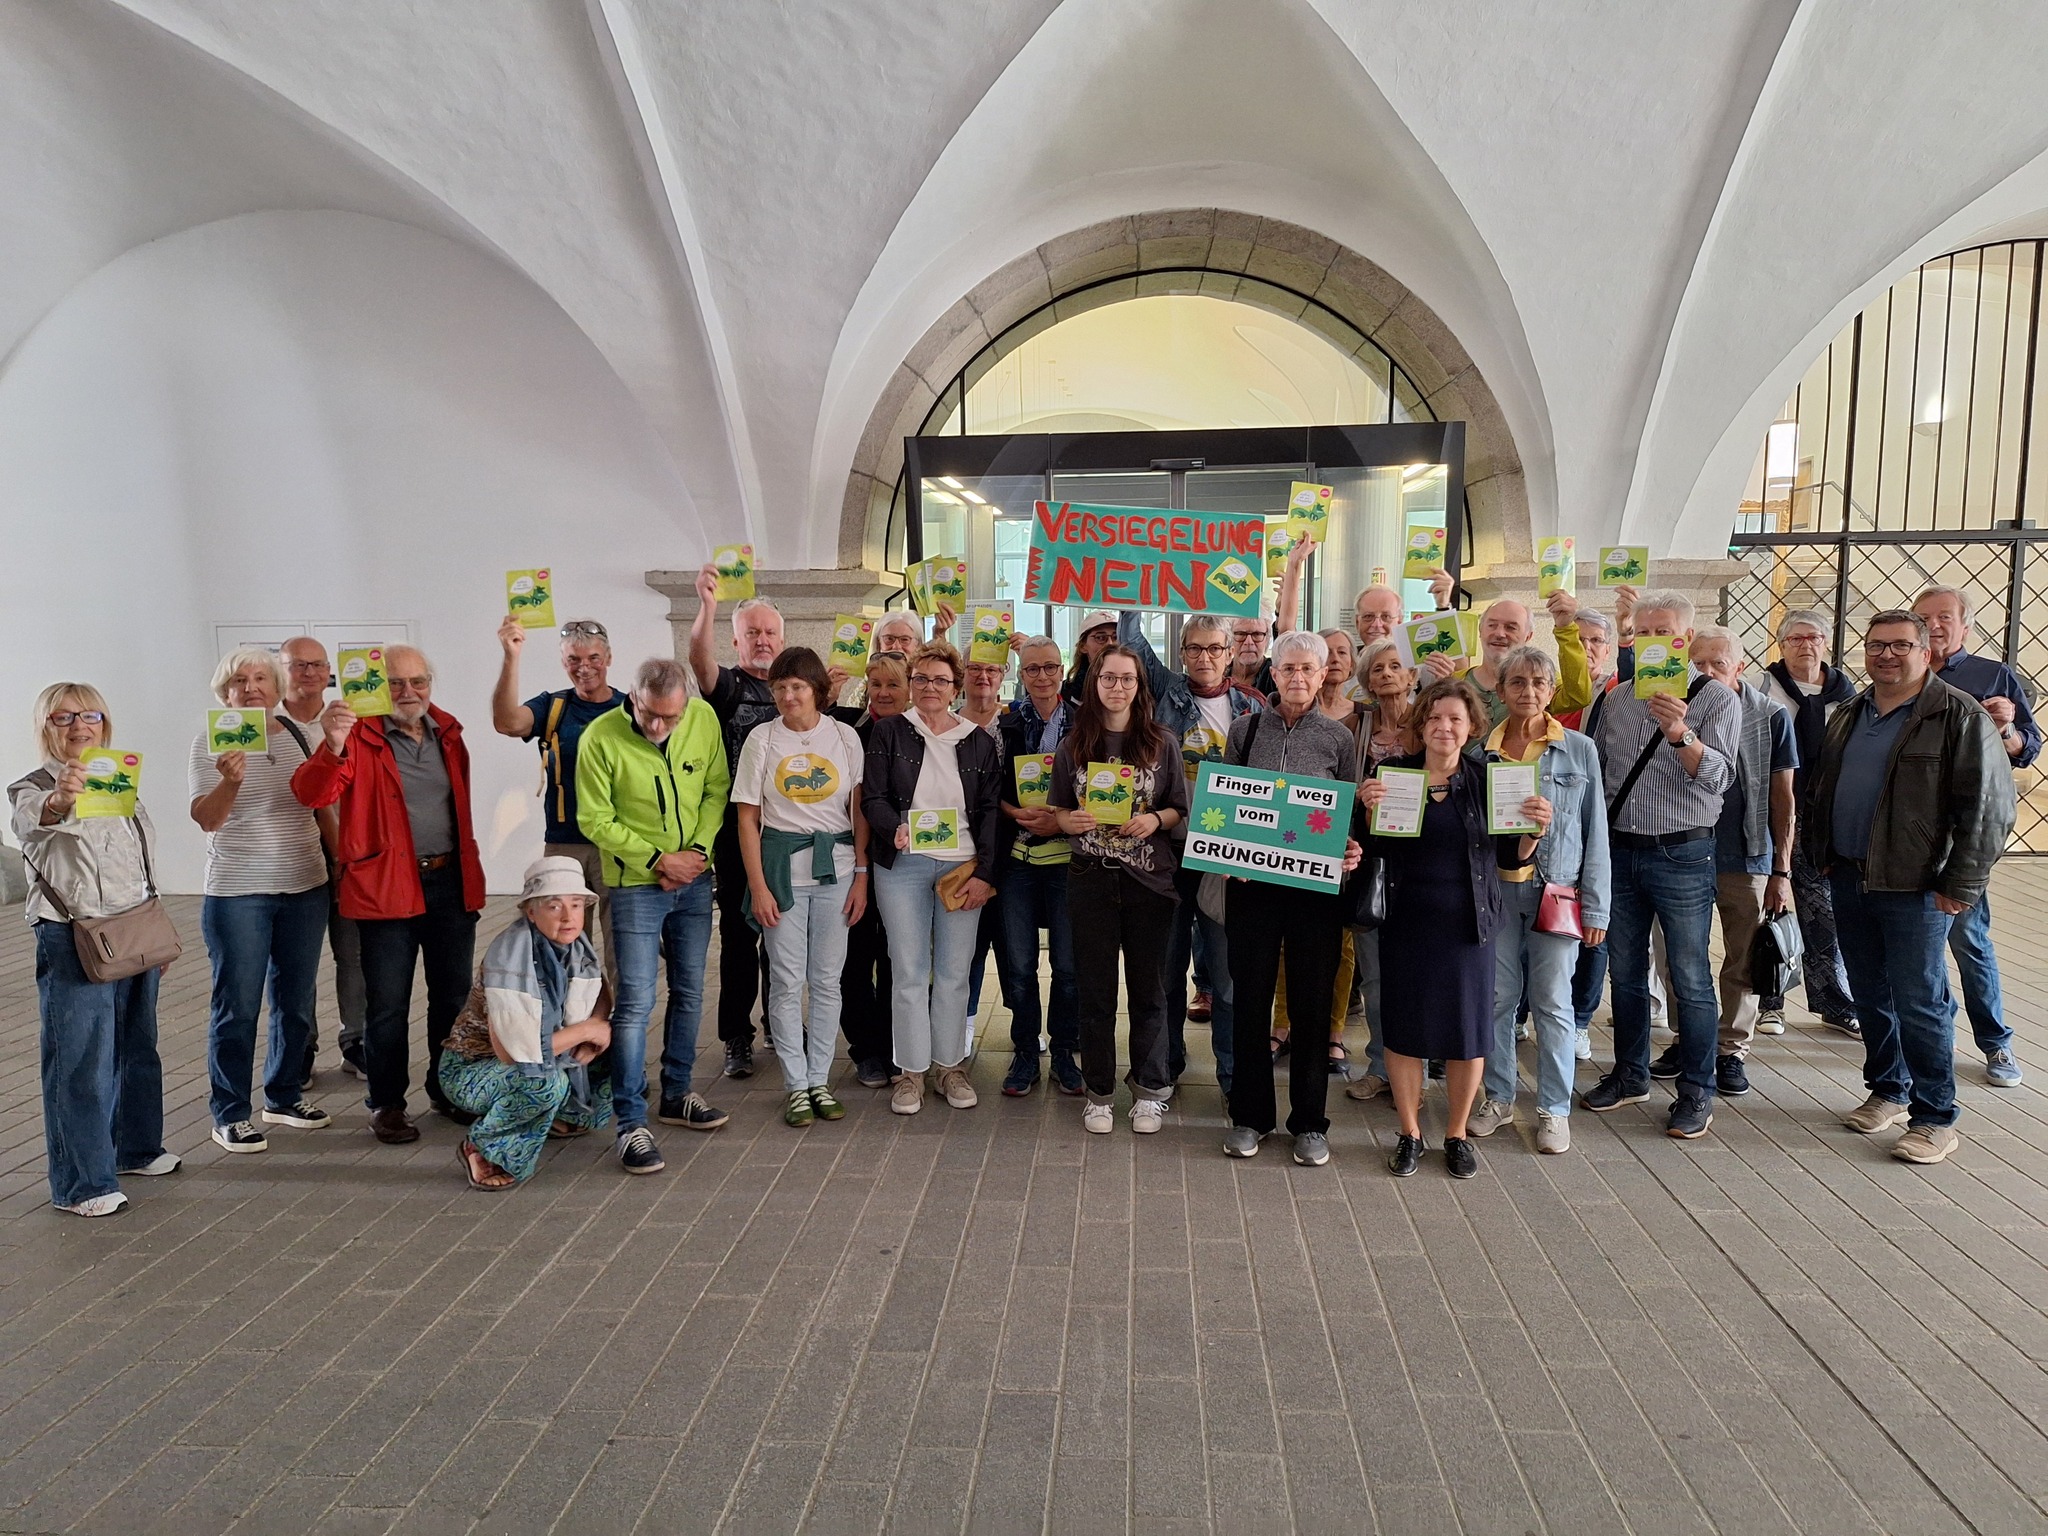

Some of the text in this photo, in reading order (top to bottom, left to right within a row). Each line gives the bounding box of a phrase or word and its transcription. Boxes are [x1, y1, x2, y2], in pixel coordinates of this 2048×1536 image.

[1035, 501, 1266, 559] VERSIEGELUNG
[1050, 556, 1210, 611] NEIN
[1215, 775, 1334, 806] Finger weg
[1238, 808, 1274, 823] vom
[1192, 839, 1335, 880] GRÜNGÜRTEL
